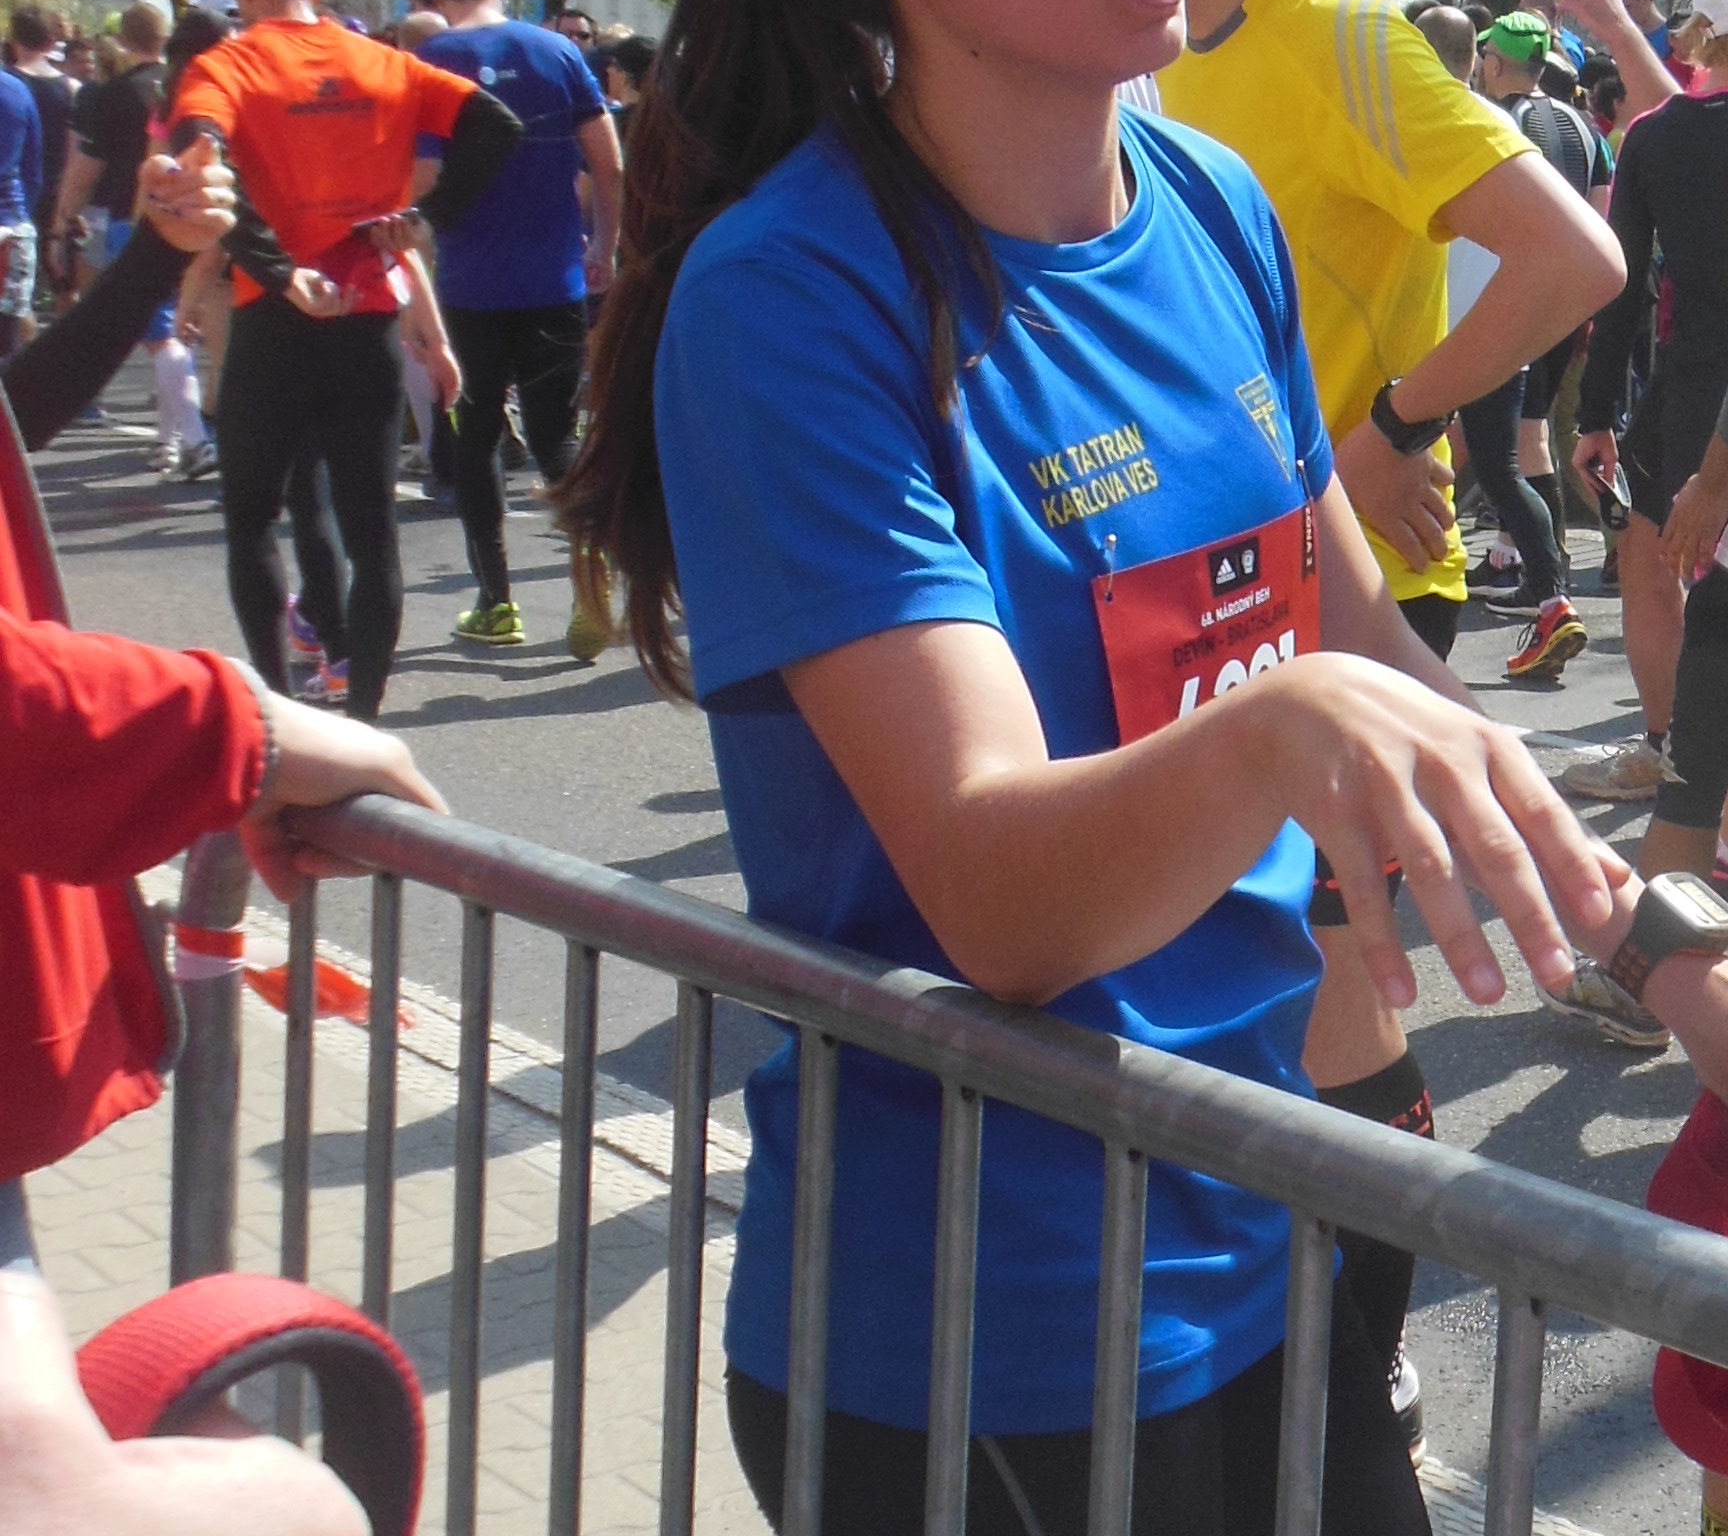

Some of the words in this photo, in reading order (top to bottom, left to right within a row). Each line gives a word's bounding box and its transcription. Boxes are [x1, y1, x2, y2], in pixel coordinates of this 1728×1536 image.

[1028, 451, 1071, 490] VK
[1066, 422, 1145, 475] TATRAN
[1041, 470, 1129, 528] KARLOVA
[1123, 457, 1160, 505] VES
